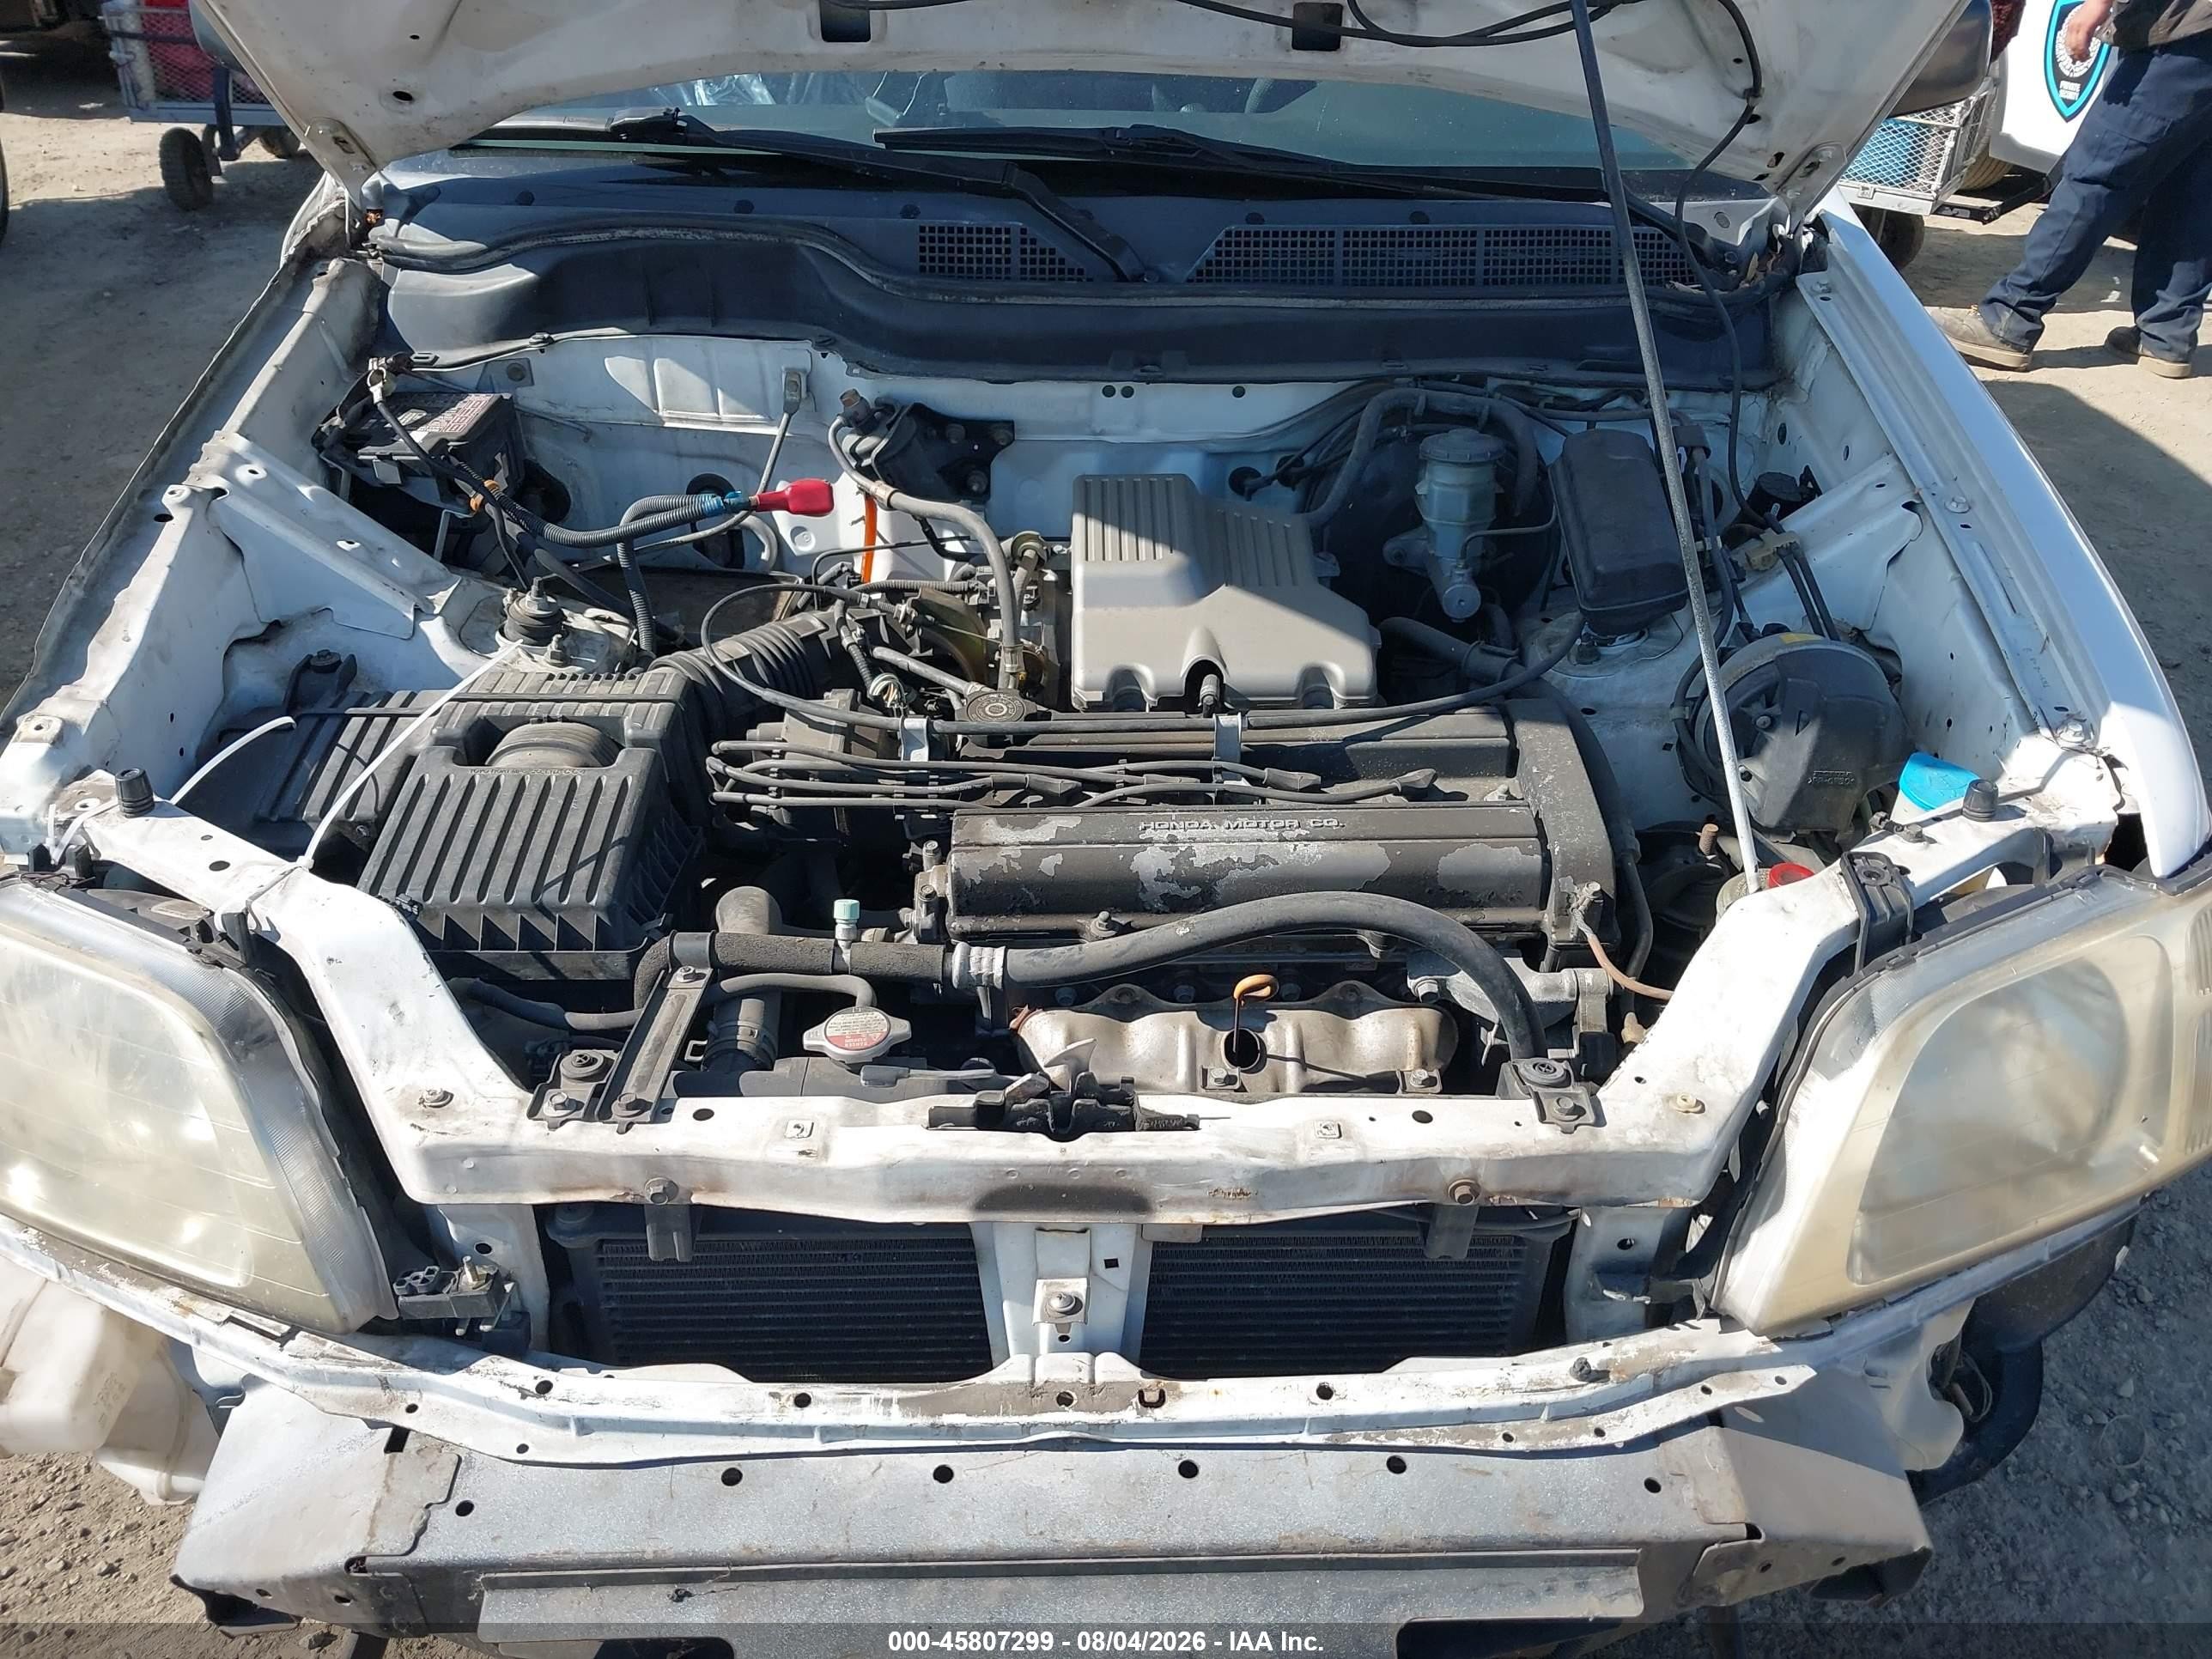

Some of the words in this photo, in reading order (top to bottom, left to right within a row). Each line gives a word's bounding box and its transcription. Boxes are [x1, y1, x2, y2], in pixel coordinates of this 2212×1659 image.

[1139, 819, 1216, 830] HONDA
[1223, 818, 1301, 830] MOTOR
[1310, 818, 1346, 829] CO.
